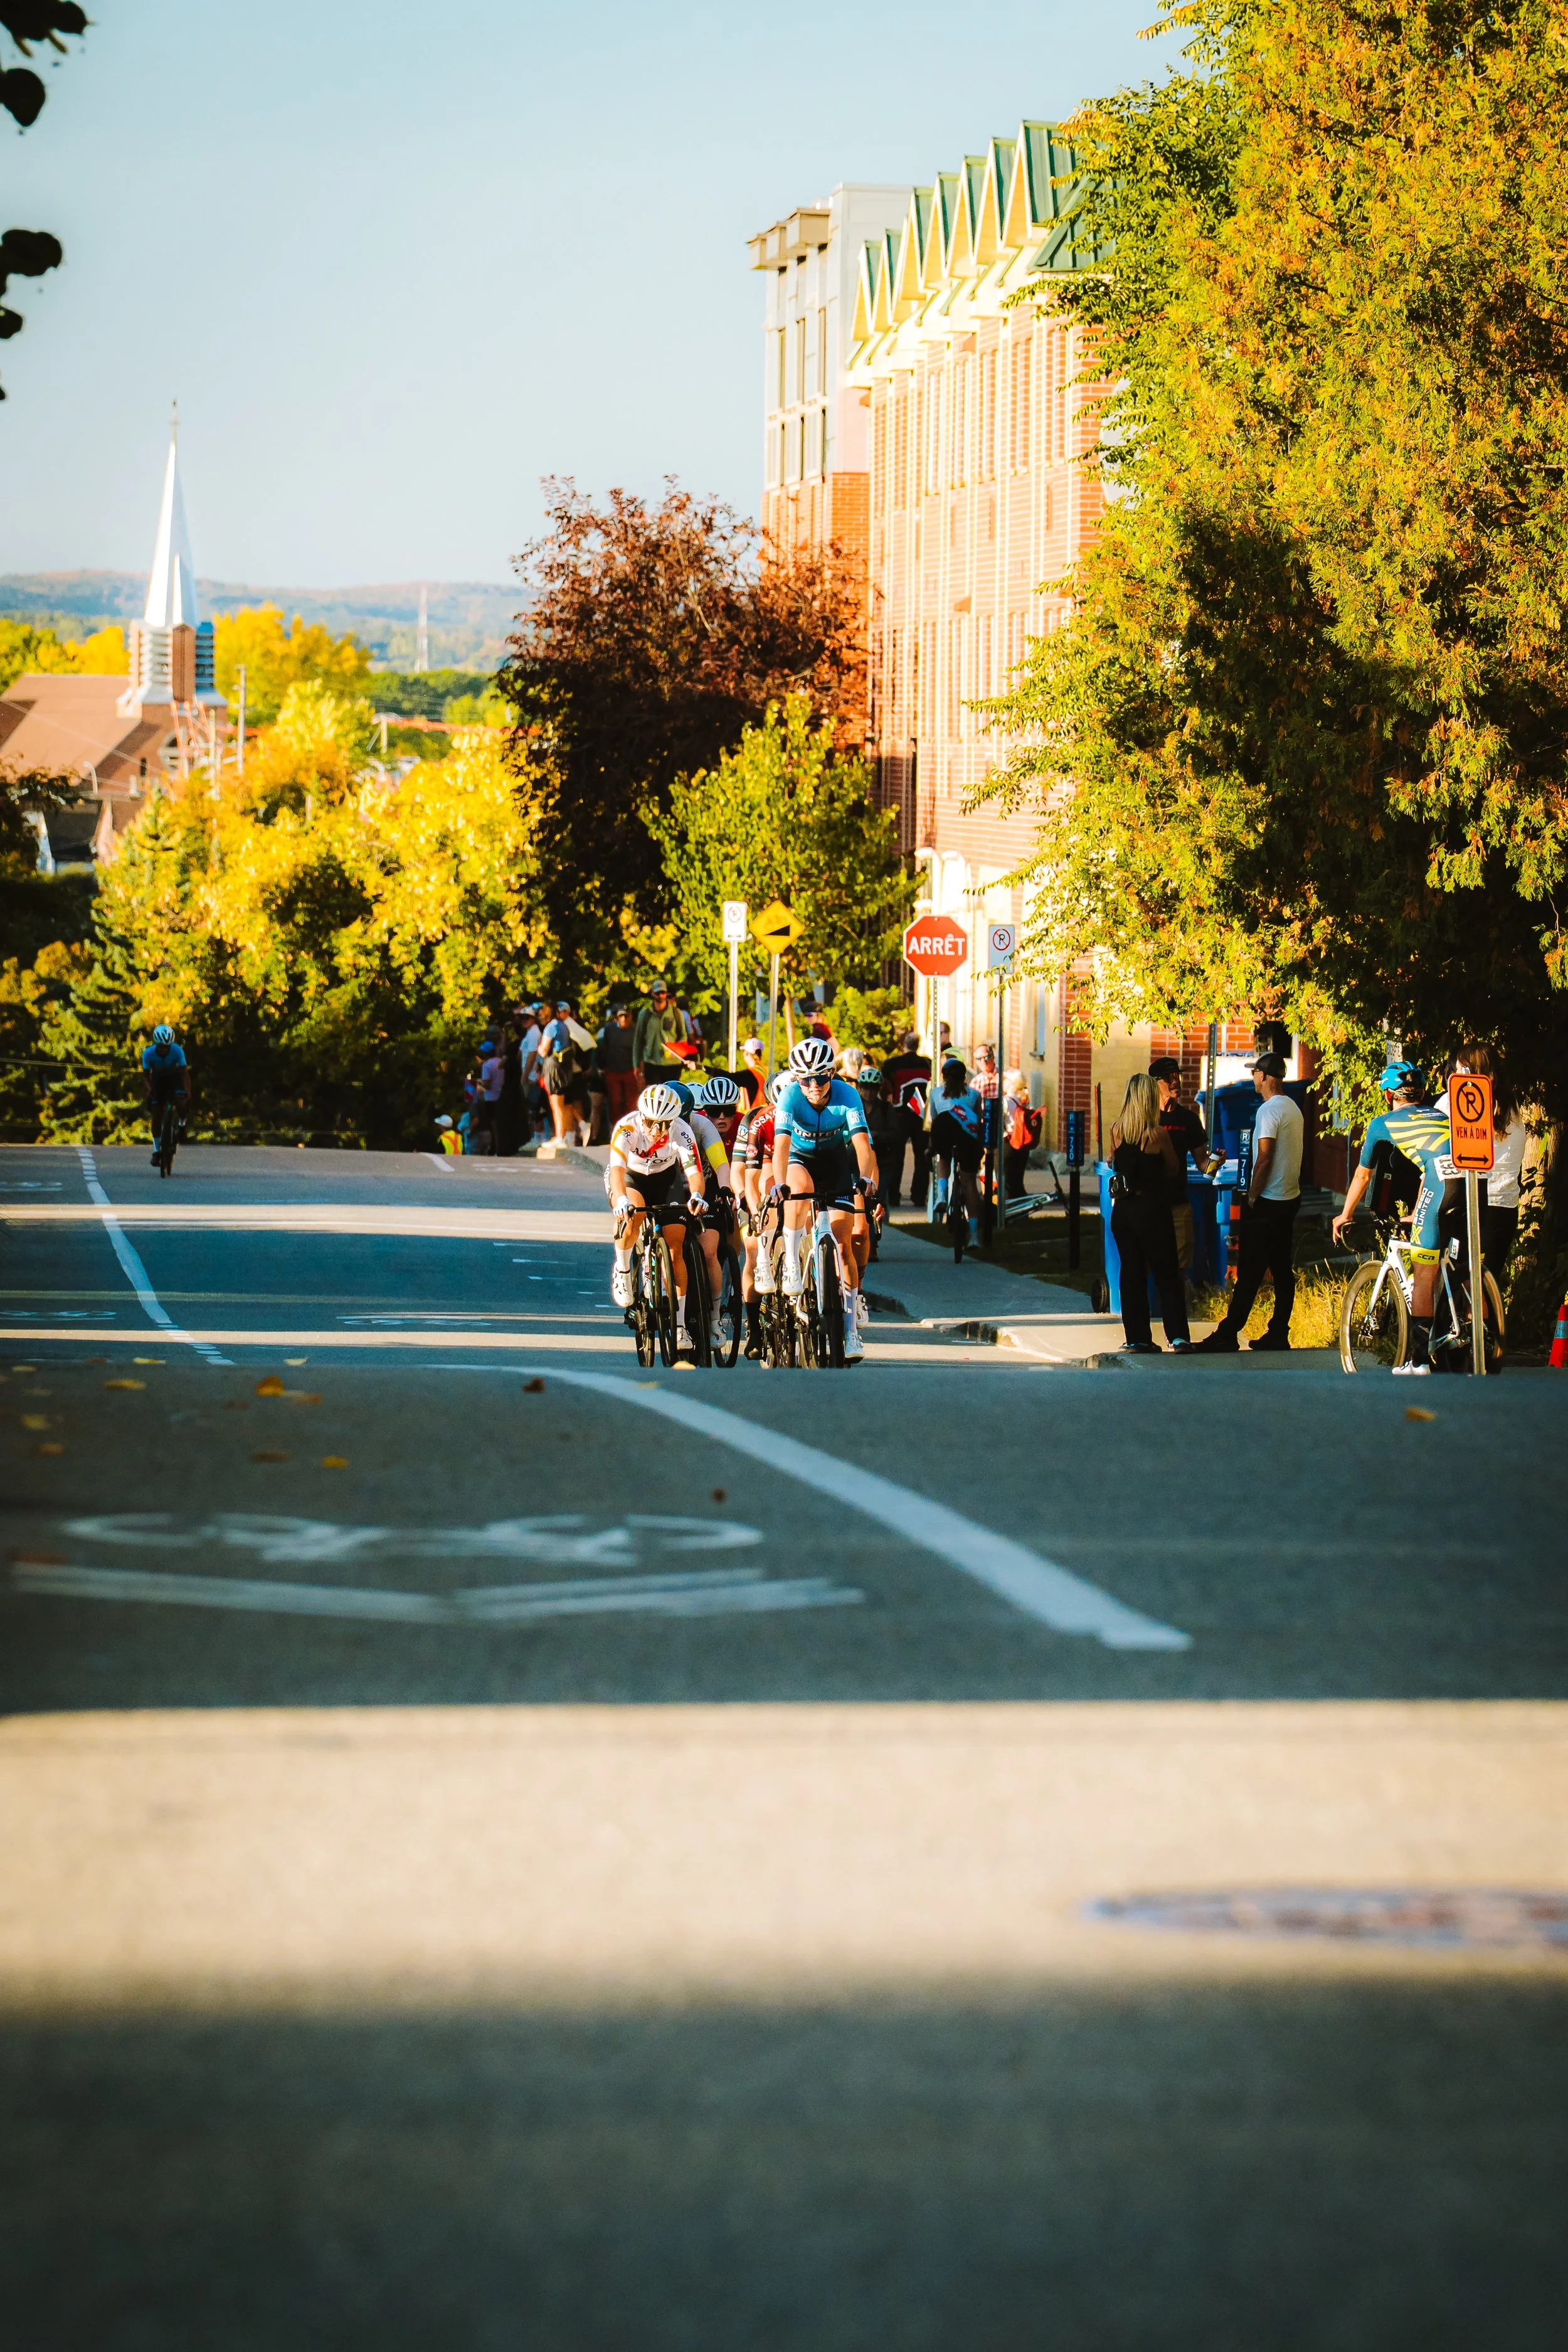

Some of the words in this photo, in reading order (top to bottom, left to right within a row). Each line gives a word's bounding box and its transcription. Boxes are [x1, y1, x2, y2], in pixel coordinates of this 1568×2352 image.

[908, 933, 966, 956] ARRÊT
[681, 1131, 694, 1151] place
[793, 1128, 840, 1138] UNITED
[1456, 1126, 1468, 1138] VEN
[1470, 1125, 1474, 1139] À
[1476, 1128, 1487, 1140] DIM
[632, 1147, 658, 1158] ANA
[1417, 1190, 1434, 1226] UNITED
